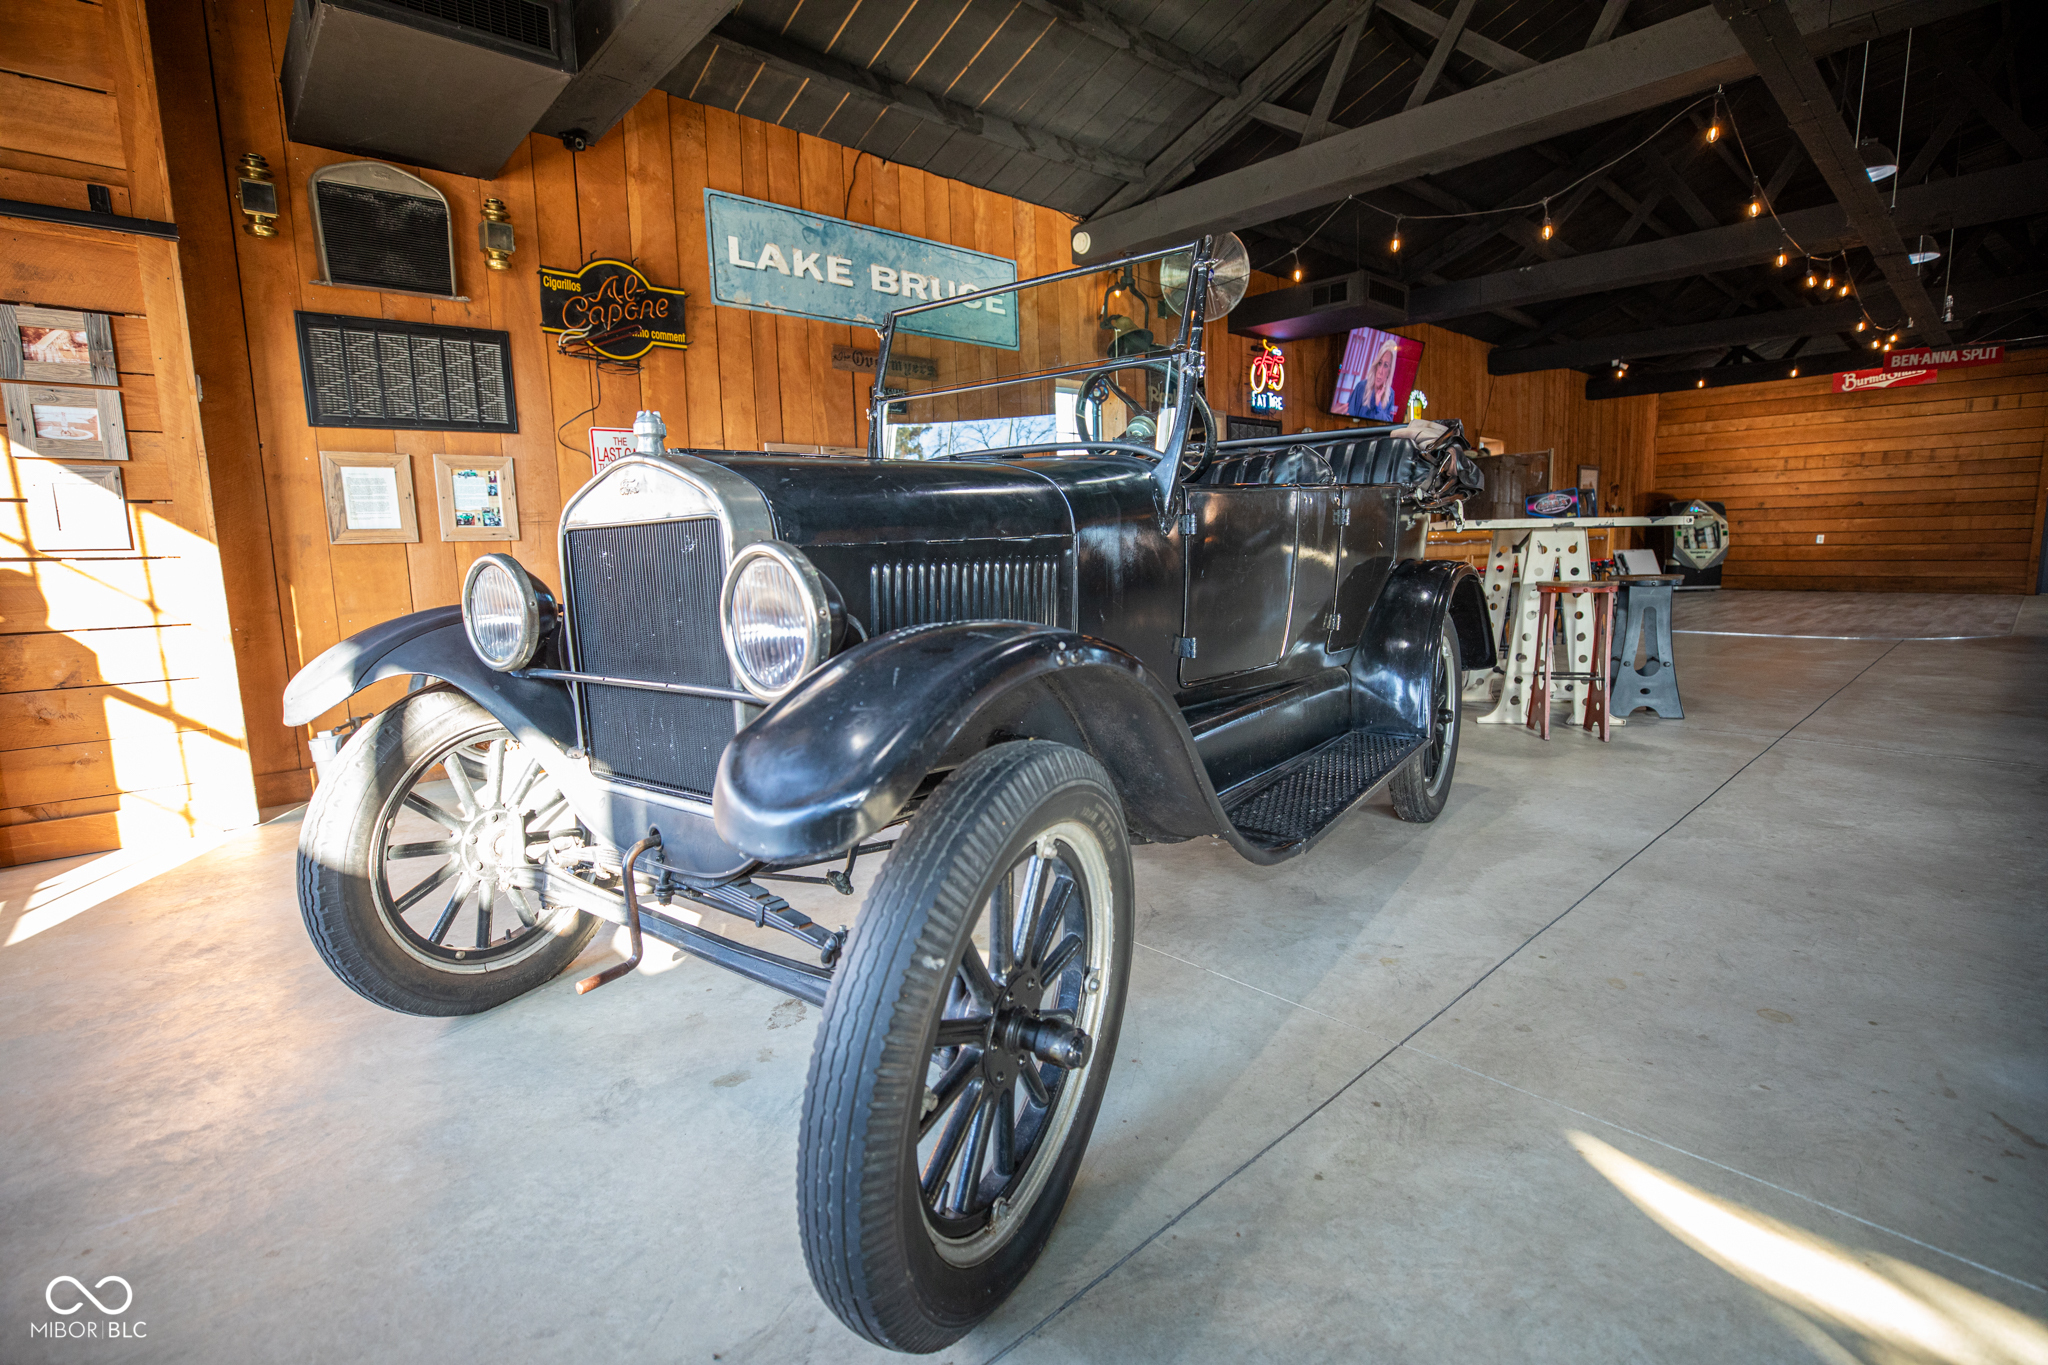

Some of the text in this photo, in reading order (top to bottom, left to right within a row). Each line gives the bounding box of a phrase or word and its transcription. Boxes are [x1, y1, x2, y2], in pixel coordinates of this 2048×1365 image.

[542, 275, 582, 293] Cigarillos
[728, 235, 1006, 316] LAKE BRUCE
[562, 296, 668, 331] Capone
[651, 330, 686, 343] comment
[1890, 346, 1999, 368] BEN-ANNA SPLIT
[1251, 390, 1284, 411] FAT TIRE
[612, 436, 628, 446] THE
[596, 446, 622, 462] LAST
